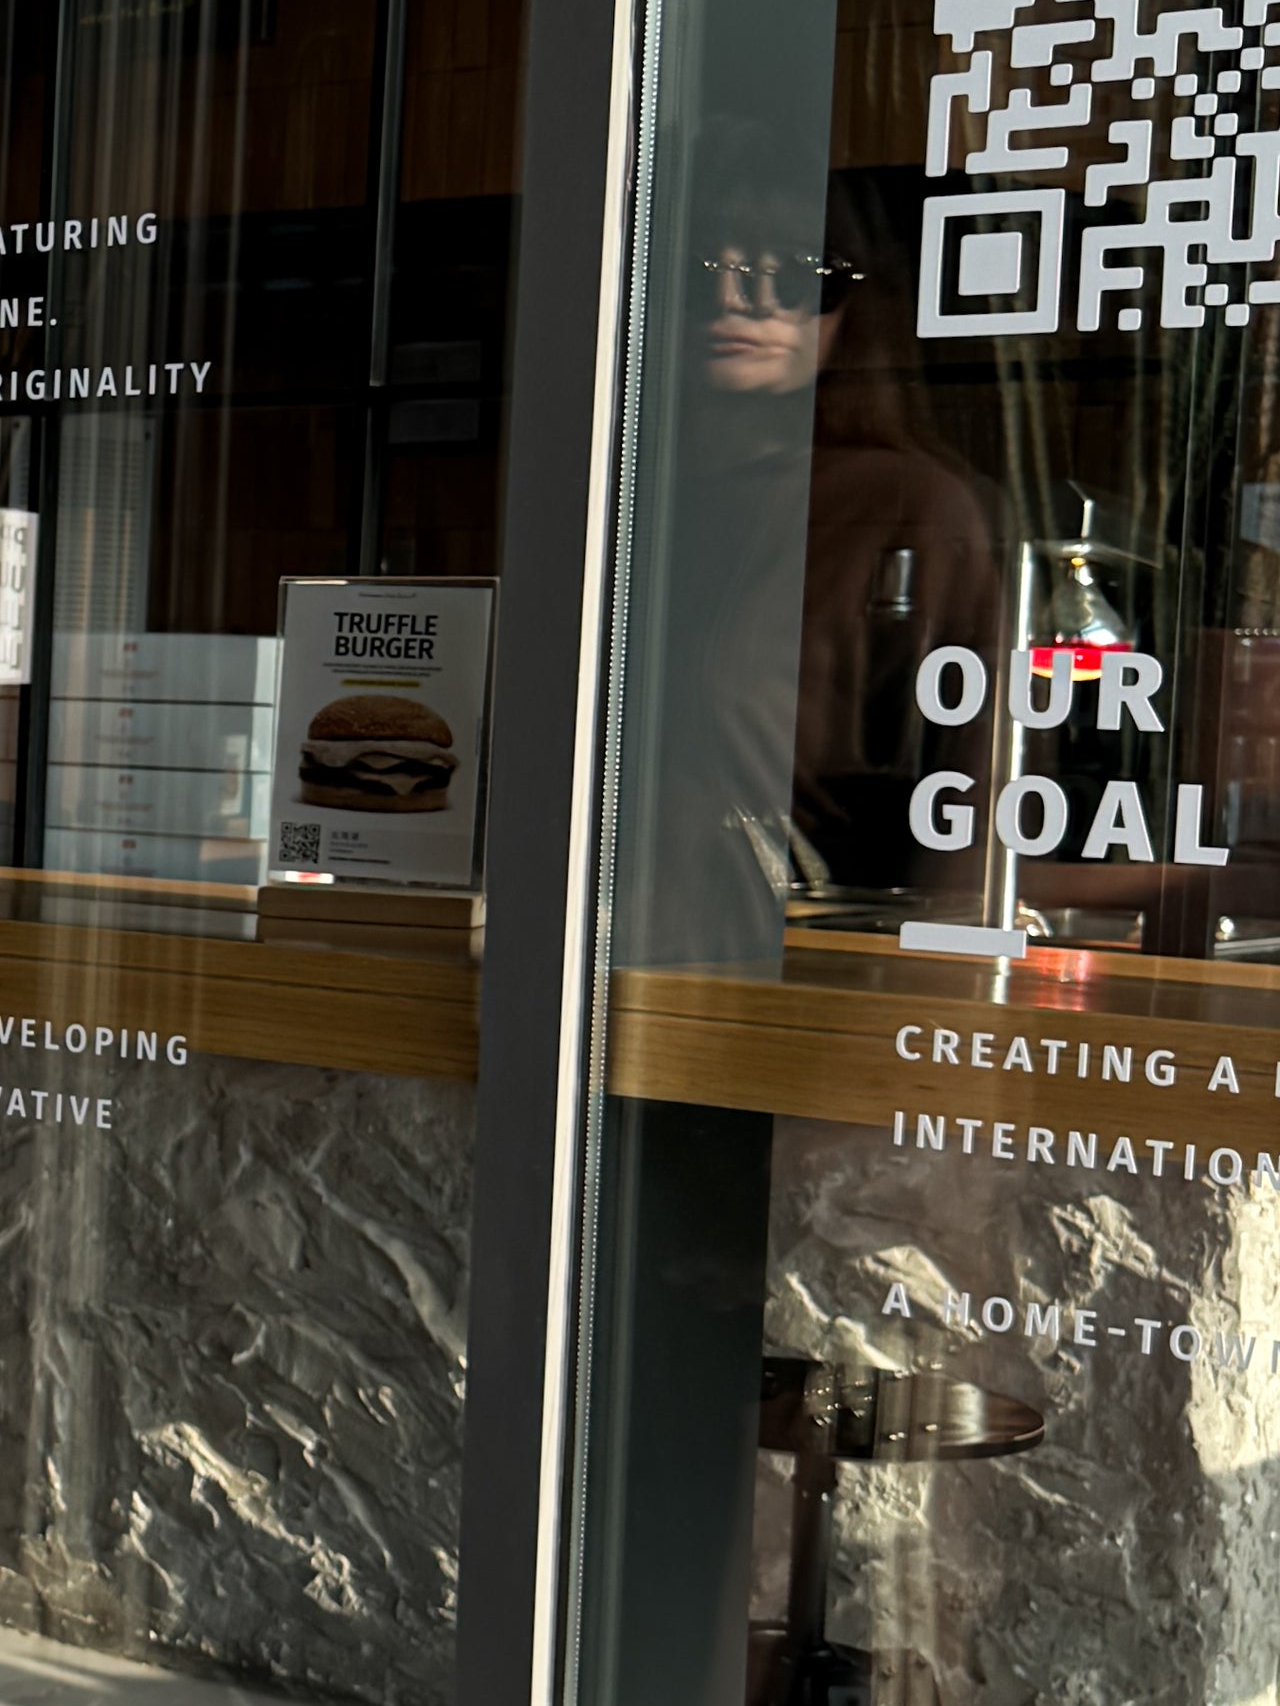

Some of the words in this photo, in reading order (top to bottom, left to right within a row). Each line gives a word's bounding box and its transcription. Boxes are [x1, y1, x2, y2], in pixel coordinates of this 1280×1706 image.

[334, 612, 439, 637] TRUFFLE
[335, 636, 435, 660] BURGER
[915, 644, 1166, 734] OUR
[909, 770, 1232, 867] GOAL
[895, 1024, 1178, 1088] CREATING
[1207, 1055, 1240, 1094] A
[881, 1281, 912, 1319] A
